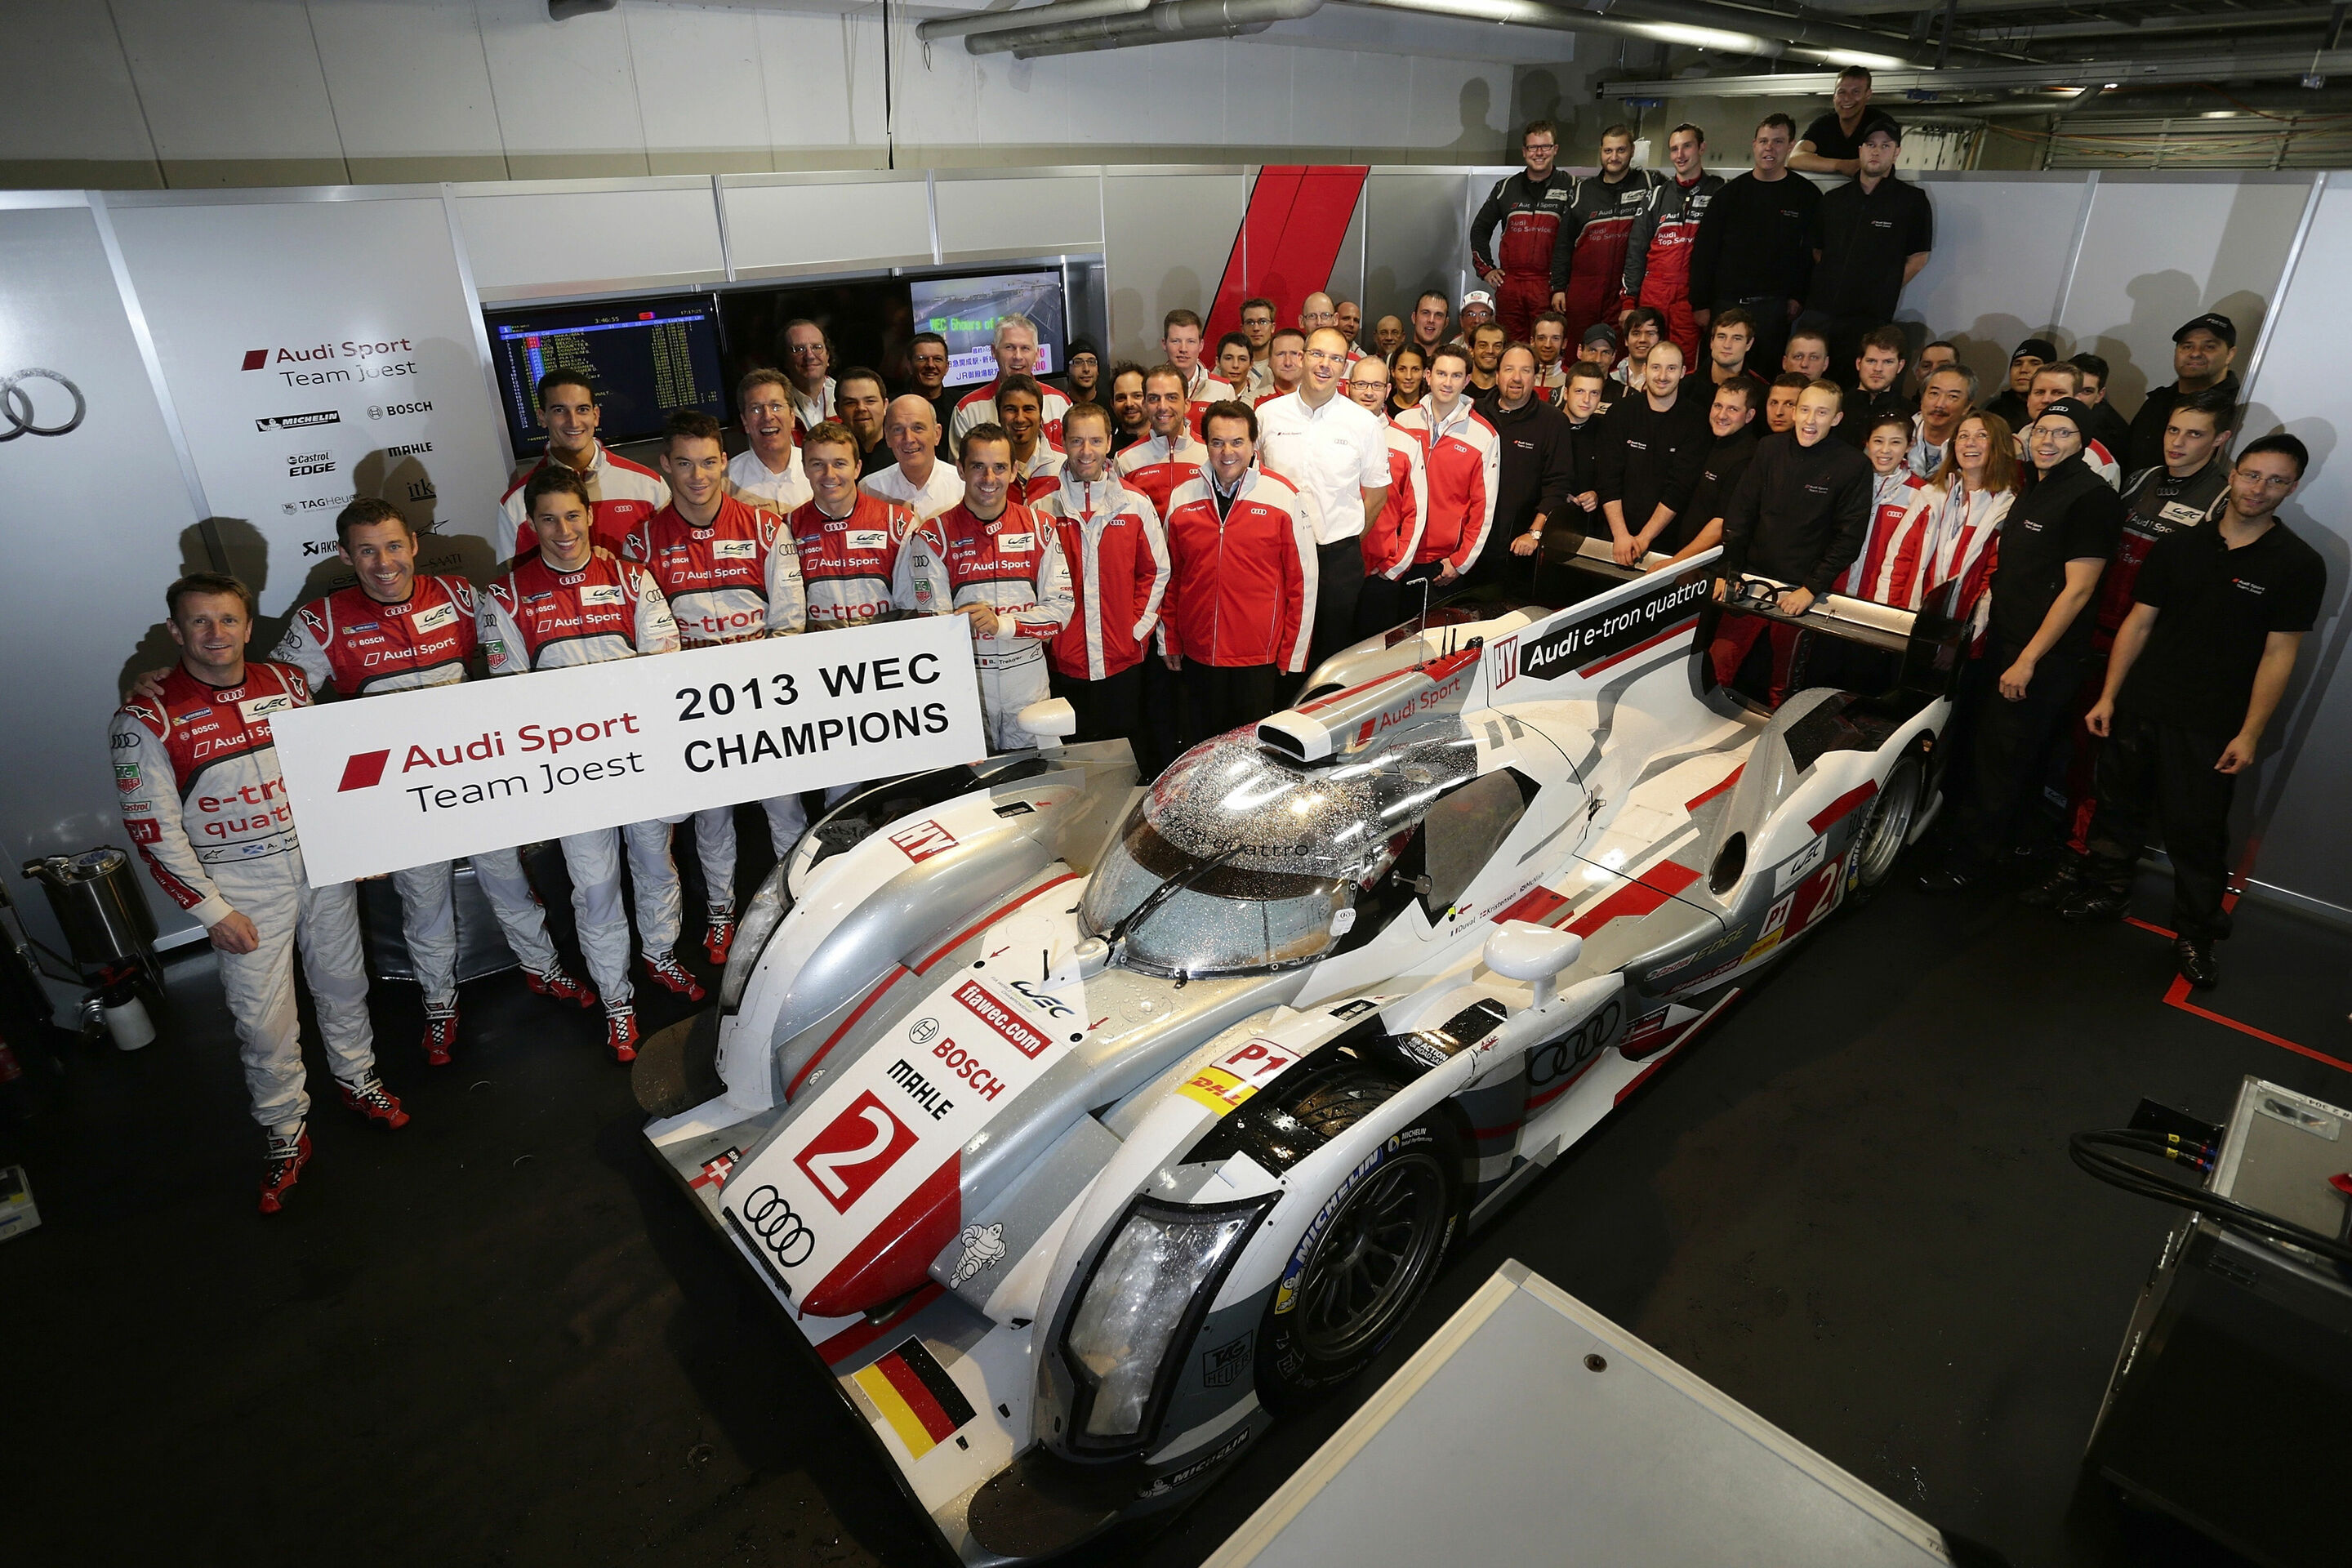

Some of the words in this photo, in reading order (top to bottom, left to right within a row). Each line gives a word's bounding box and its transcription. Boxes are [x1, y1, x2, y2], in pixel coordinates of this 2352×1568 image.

[951, 317, 981, 331] 6hours
[276, 343, 335, 363] Audi
[341, 338, 412, 359] Sport
[279, 369, 350, 387] Team
[356, 361, 418, 382] Joest
[282, 412, 338, 426] MICHELIN
[387, 401, 433, 416] BOSCH
[297, 452, 330, 464] Castrol
[387, 442, 433, 457] MAHLE
[289, 461, 336, 478] EDGE
[407, 478, 434, 498] itk
[428, 553, 461, 568] SAATI
[687, 571, 711, 581] Audi
[714, 567, 748, 579] Sport
[819, 558, 846, 568] Audi
[849, 556, 880, 568] Sport
[972, 561, 999, 571] Audi
[1001, 559, 1031, 571] Sport
[555, 616, 583, 628] Audi
[586, 612, 621, 626] Sport
[677, 608, 764, 634] e-tron
[809, 599, 889, 621] e-tron
[1527, 630, 1579, 672] Audi
[1584, 608, 1641, 647] e-tron
[1646, 578, 1708, 624] quattro
[359, 635, 385, 646] BOSCH
[383, 648, 417, 661] Audi
[420, 637, 456, 654] Sport
[1494, 639, 1517, 689] HY
[676, 674, 799, 722] 2013
[818, 653, 941, 698] WEC
[1379, 696, 1415, 732] Audi
[1420, 676, 1461, 710] Sport
[191, 722, 220, 735] BOSCH
[214, 728, 254, 750] Audi
[685, 703, 950, 773] CHAMPIONS
[403, 729, 505, 773] Audi
[519, 713, 640, 755] Sport
[407, 776, 528, 813] Team
[540, 752, 646, 795] Joest
[893, 822, 956, 857] HY
[1790, 840, 1823, 877] WEC
[1458, 916, 1476, 933] Duval
[1486, 892, 1517, 915] Kristensen
[1524, 871, 1544, 890] McNish
[1806, 862, 1838, 924] 2
[1764, 898, 1792, 934] P1
[1693, 923, 1749, 963] EDGE
[1010, 981, 1076, 1018] WEC
[960, 985, 1041, 1052] fiawec.com
[1225, 1044, 1289, 1076] P1
[1414, 1045, 1433, 1059] ROAD
[1421, 1041, 1449, 1062] ACTION
[932, 1037, 1006, 1102] BOSCH
[886, 1058, 955, 1122] MAHLE
[1190, 1076, 1242, 1107] DHL
[1401, 1128, 1428, 1140] MICHELIN
[805, 1104, 895, 1200] 2
[1295, 1148, 1379, 1265] MICHELIN
[1206, 1352, 1251, 1386] HEUER
[1173, 1430, 1248, 1484] MICHELIN
